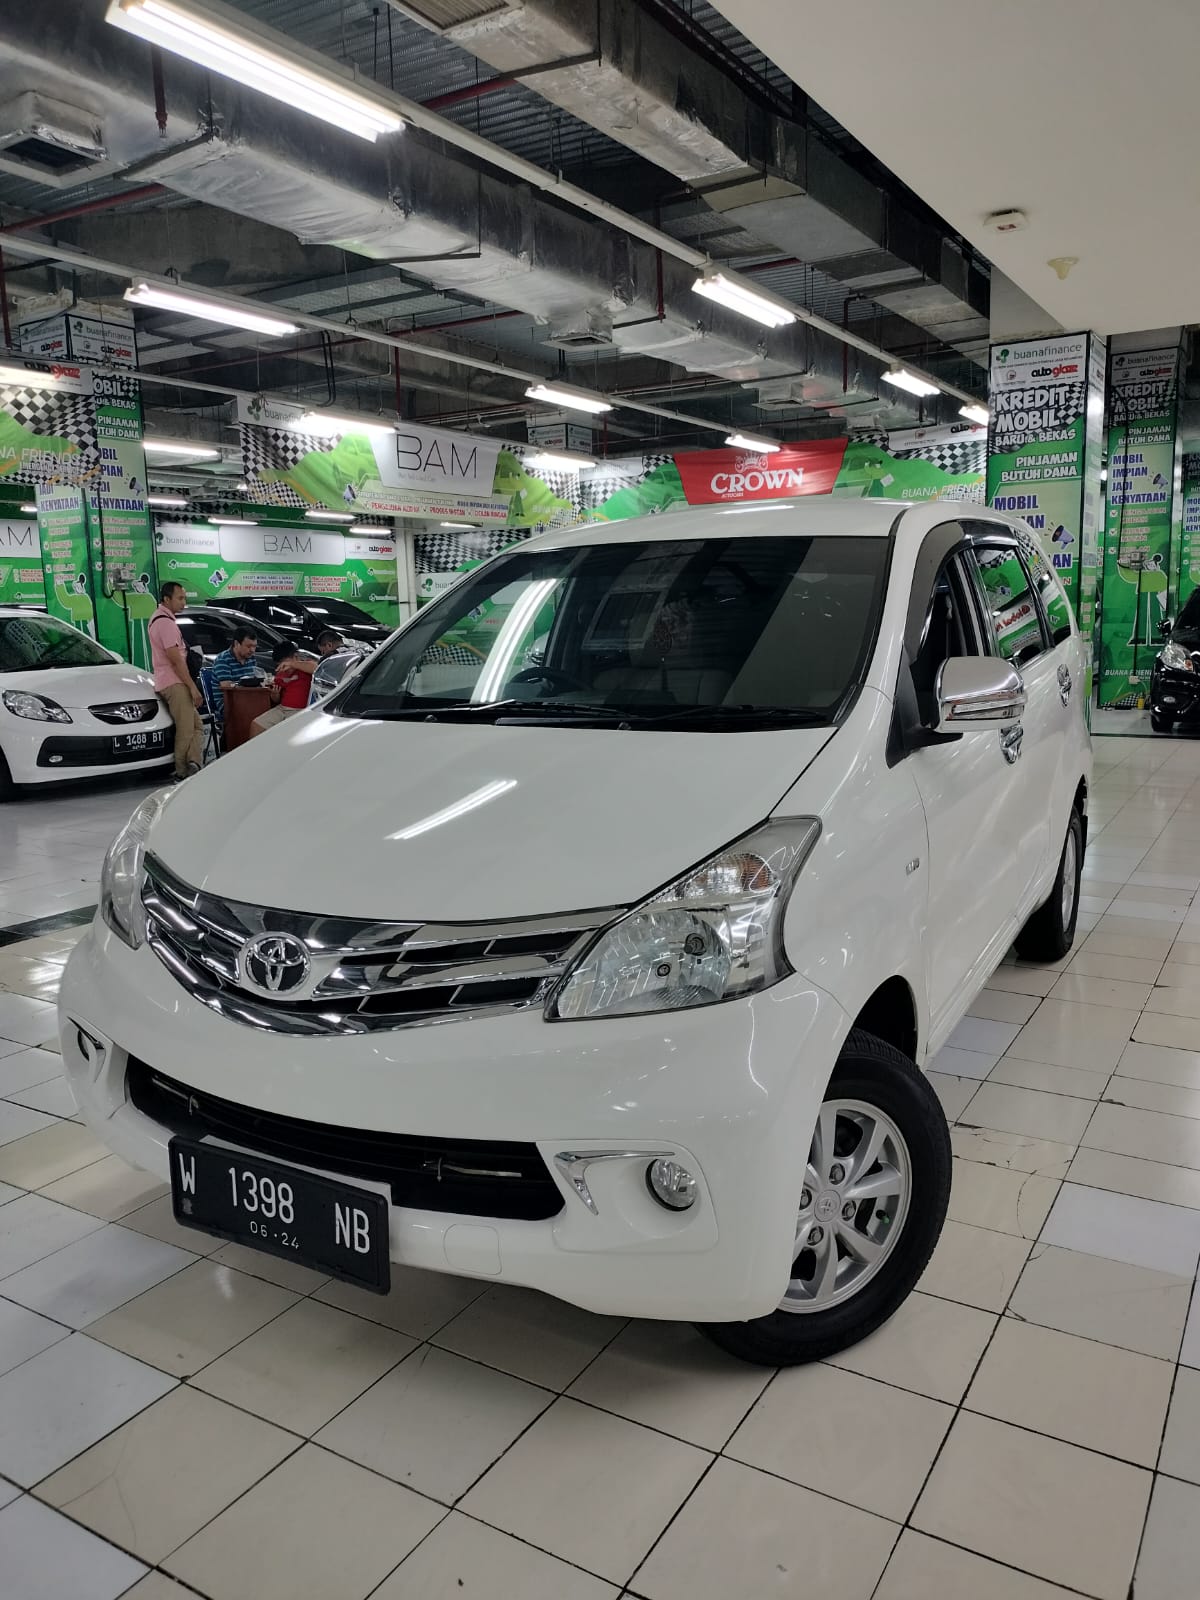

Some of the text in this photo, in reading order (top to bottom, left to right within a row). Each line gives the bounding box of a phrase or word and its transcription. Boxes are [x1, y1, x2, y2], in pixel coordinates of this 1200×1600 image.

[1013, 344, 1082, 360] buanafinance
[93, 379, 125, 396] OBIL
[1116, 381, 1167, 398] KREDIT
[111, 398, 137, 410] BEKAS
[996, 386, 1070, 412] KREDIT
[1114, 397, 1160, 413] MOBIL
[98, 415, 139, 429] PINJAMAN
[995, 408, 1060, 433] MOBIL
[118, 428, 140, 439] DANA
[995, 433, 1025, 447] BARU
[1039, 428, 1076, 443] BEKAS
[1128, 425, 1172, 435] PINJAMAN
[1147, 434, 1171, 443] DANA
[396, 433, 478, 479] BAM
[1016, 452, 1078, 467] PINJAMAN
[1112, 453, 1145, 465] MOBIL
[1001, 466, 1077, 481] BUTUH DANA
[1112, 466, 1148, 478] IMPIAN
[710, 468, 804, 494] CROWN
[901, 486, 938, 498] BUANA
[1111, 492, 1167, 505] KENYATAAN
[91, 496, 144, 512] KENYATAAN
[994, 495, 1039, 511] MOBIL
[263, 534, 312, 553] BAM
[114, 737, 120, 748] L
[152, 731, 163, 743] BT
[179, 1153, 370, 1254] W 1398 NB
